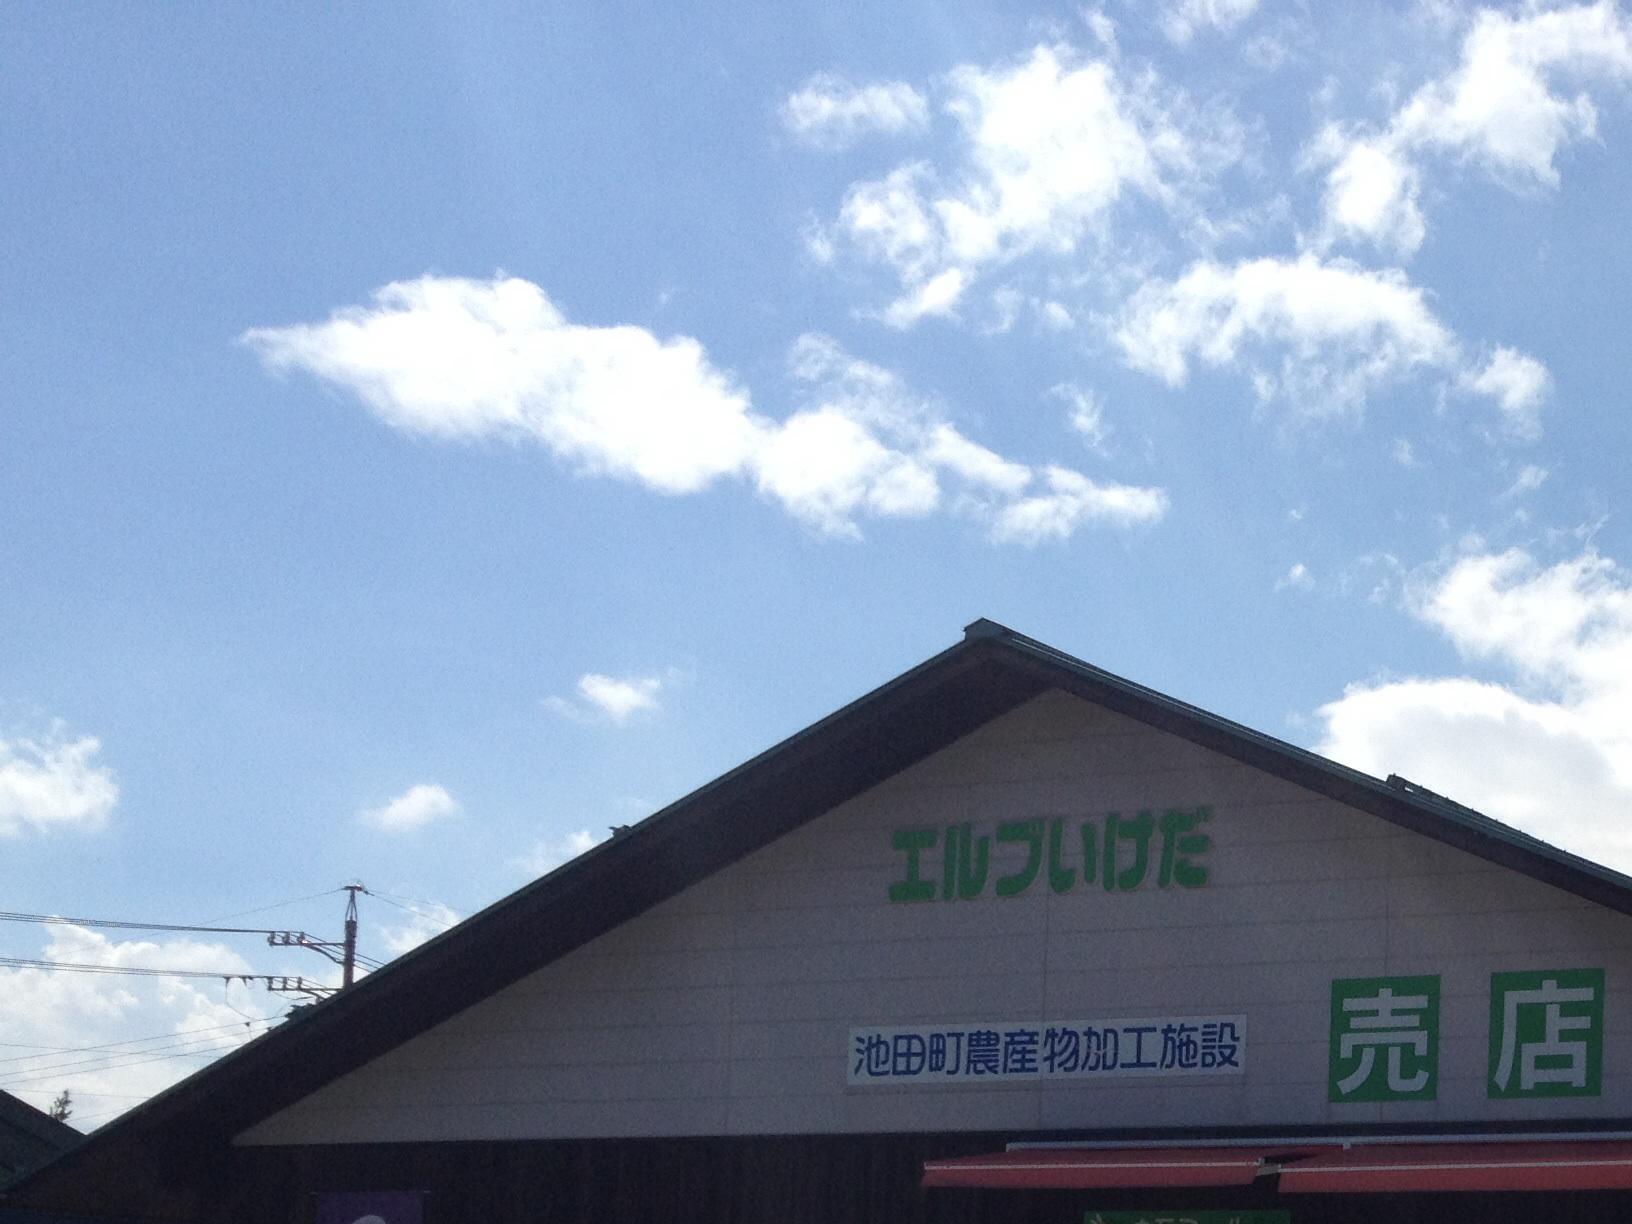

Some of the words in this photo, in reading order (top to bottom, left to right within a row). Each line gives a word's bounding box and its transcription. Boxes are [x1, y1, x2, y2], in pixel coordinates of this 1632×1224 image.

[854, 1022, 1240, 1077] 池田町農産物加工施設
[1337, 979, 1594, 1095] 売店
